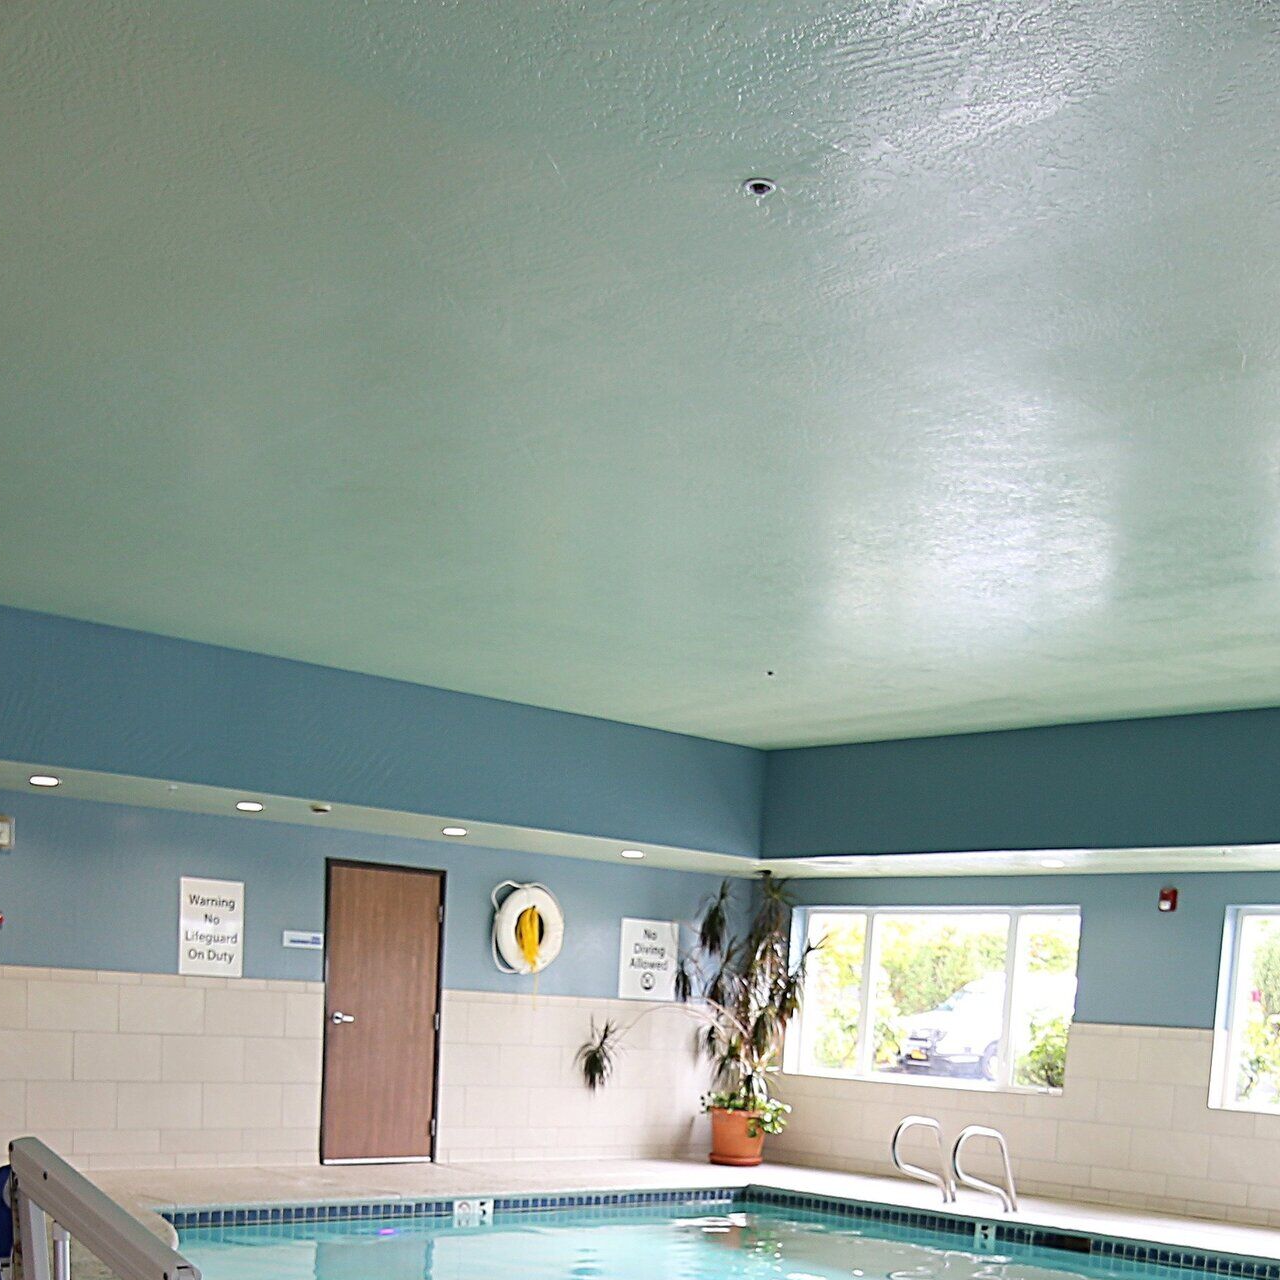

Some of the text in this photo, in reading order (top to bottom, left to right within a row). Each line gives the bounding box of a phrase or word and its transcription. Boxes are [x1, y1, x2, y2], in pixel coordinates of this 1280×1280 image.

[189, 894, 235, 911] Warning
[204, 913, 220, 925] No
[185, 930, 238, 945] Lifeguard
[644, 929, 658, 940] No
[188, 948, 234, 964] On Duty
[634, 943, 665, 959] Diving
[630, 957, 668, 971] Allowed
